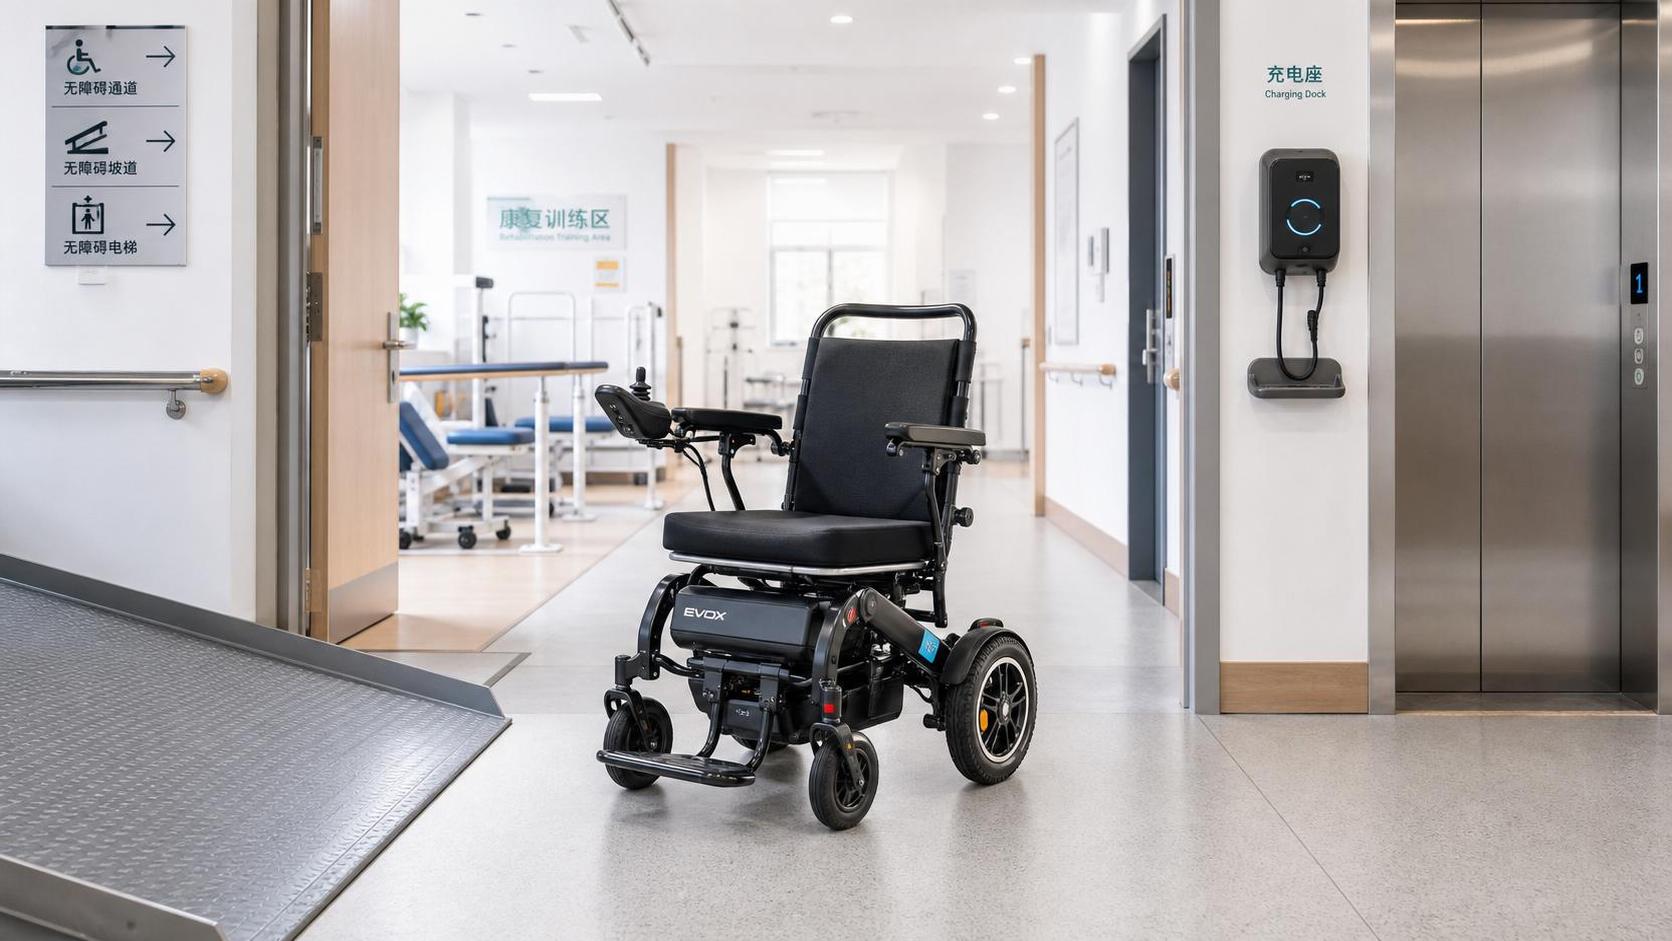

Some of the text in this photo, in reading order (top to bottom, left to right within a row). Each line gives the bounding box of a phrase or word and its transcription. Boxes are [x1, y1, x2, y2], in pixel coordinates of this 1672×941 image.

[1266, 65, 1324, 83] 充电座
[64, 81, 138, 96] 无障碍通道
[1265, 89, 1327, 100] Charging Dock
[64, 161, 138, 175] 无障碍坡道
[500, 207, 610, 230] 康复训练区
[592, 233, 611, 242] Area
[64, 240, 138, 255] 无障碍电梯
[1635, 273, 1643, 294] 1
[683, 607, 728, 621] EVOX
